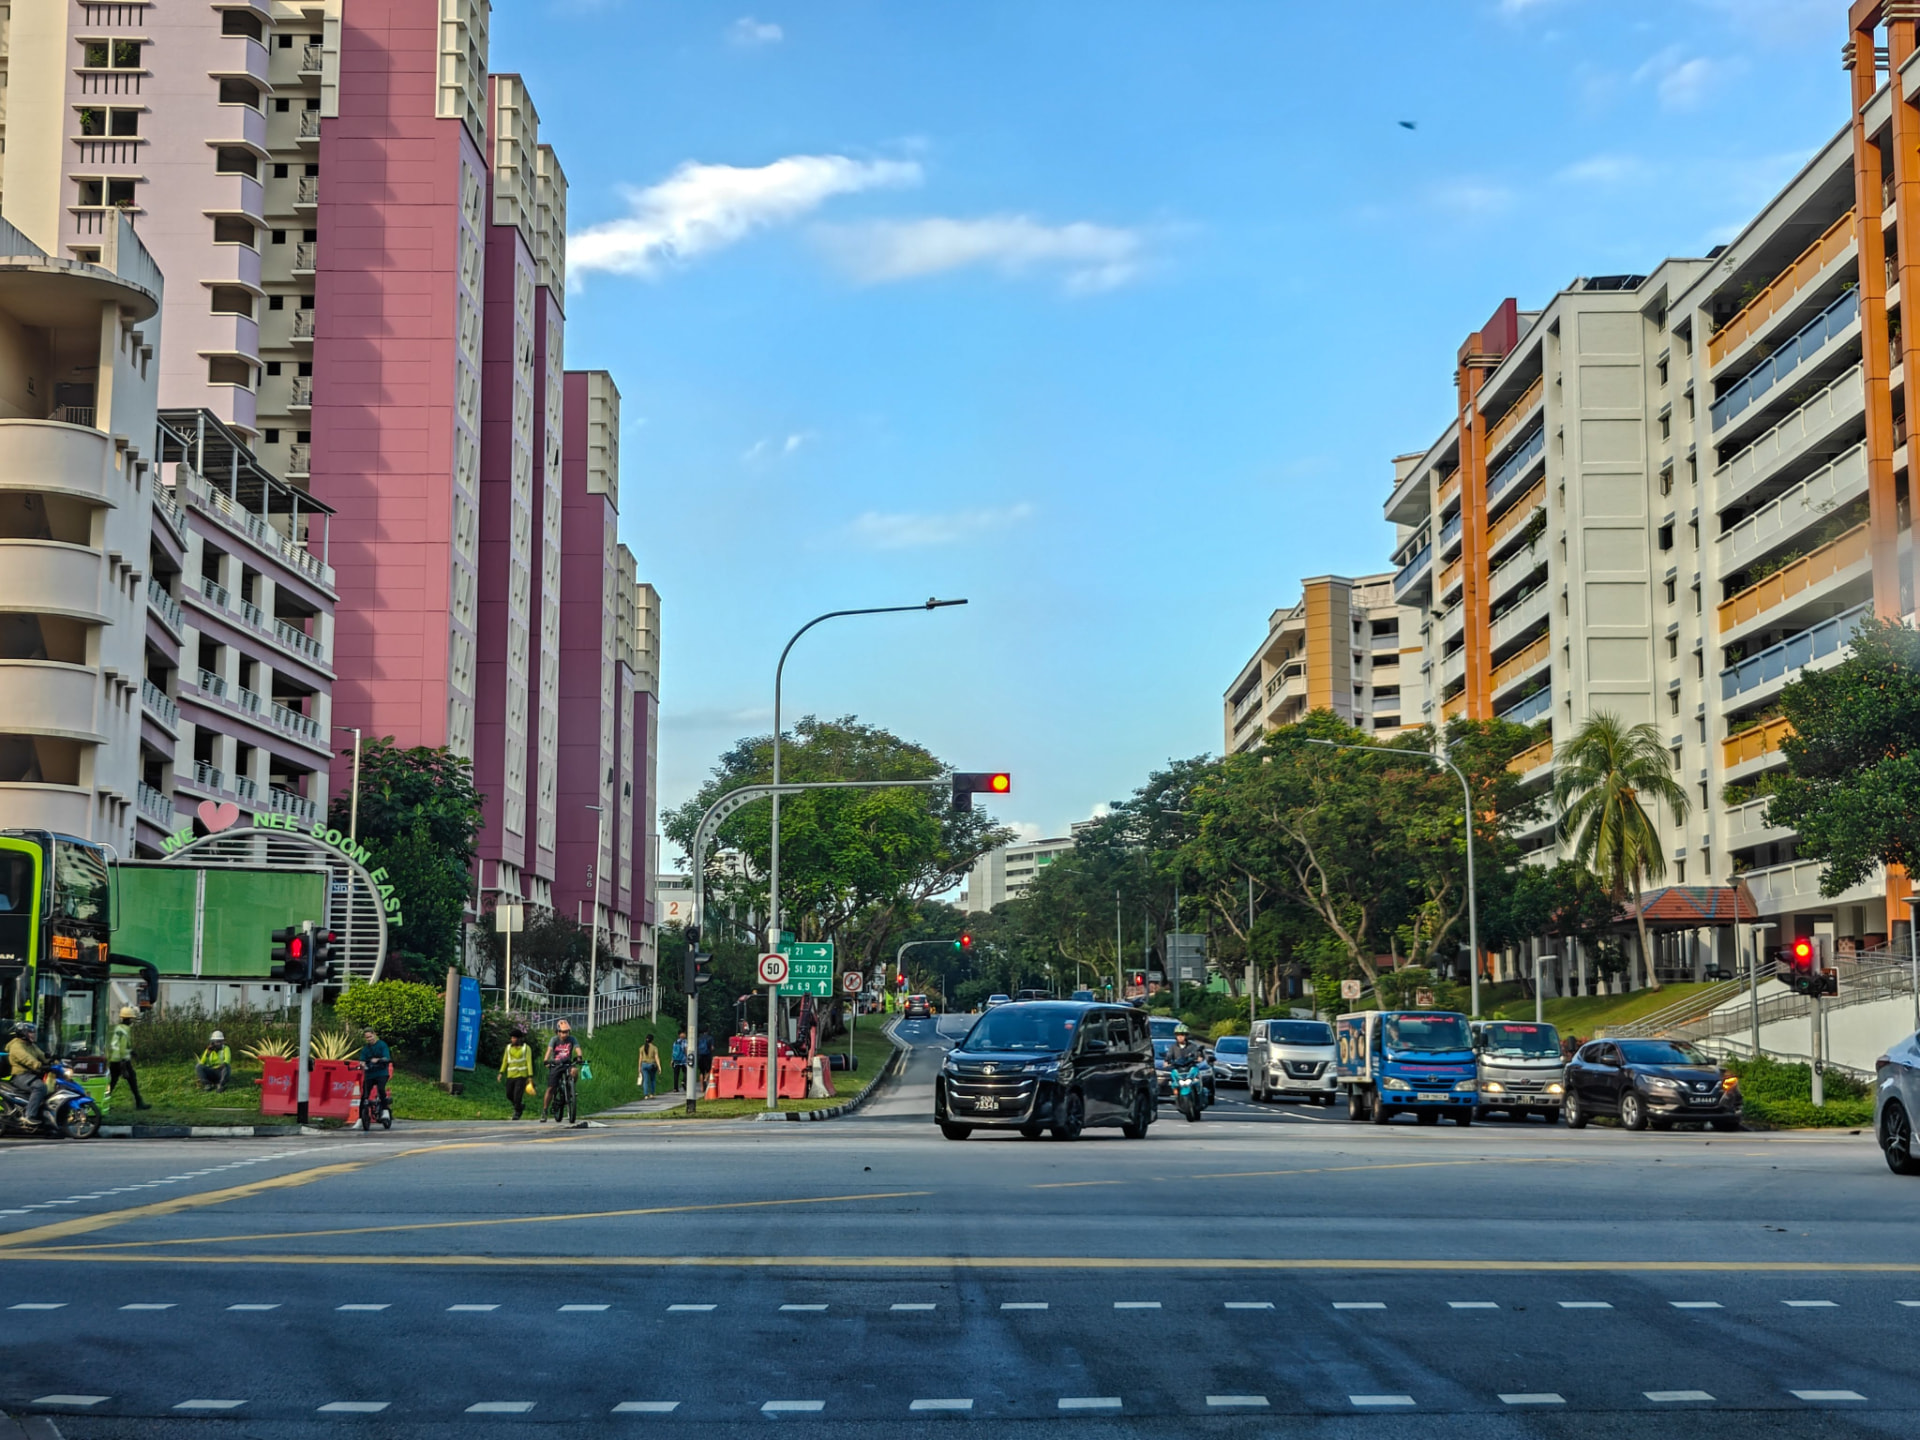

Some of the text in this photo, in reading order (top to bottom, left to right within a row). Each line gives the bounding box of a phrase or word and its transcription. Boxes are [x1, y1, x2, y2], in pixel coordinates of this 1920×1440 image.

[159, 812, 403, 927] WE NEE SOON EAST
[669, 901, 679, 916] 2
[795, 947, 804, 956] 21
[767, 962, 780, 975] 50
[794, 965, 803, 974] St
